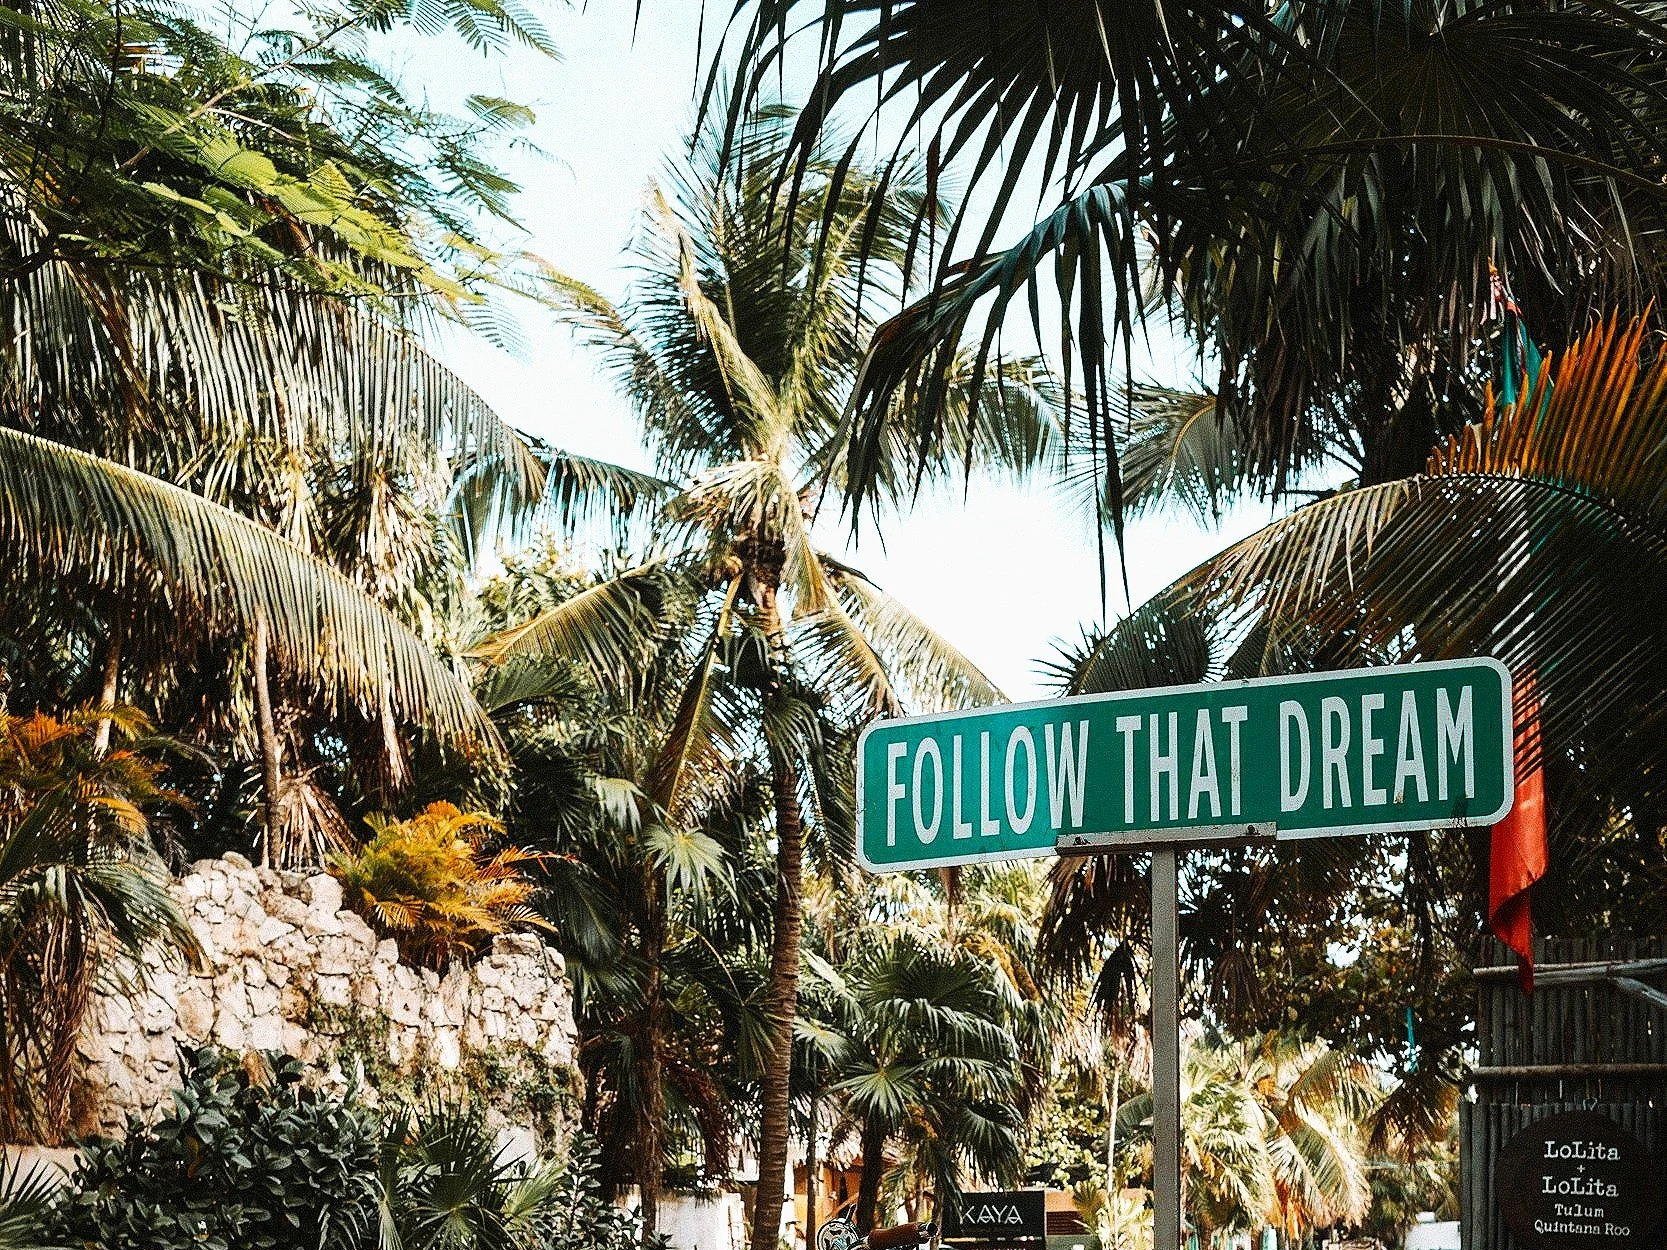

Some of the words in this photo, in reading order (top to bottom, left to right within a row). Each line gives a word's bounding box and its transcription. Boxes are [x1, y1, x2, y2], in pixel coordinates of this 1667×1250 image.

[886, 719, 1090, 848] FOLLOW
[1115, 706, 1249, 824] THAT
[1279, 684, 1475, 813] DREAM
[1543, 1140, 1621, 1161] LoLita
[1541, 1175, 1620, 1198] LoLita
[960, 1204, 1023, 1225] KAYA
[1554, 1203, 1605, 1218] Tulum
[1534, 1219, 1601, 1234] Quintana
[1604, 1222, 1631, 1237] Roo
